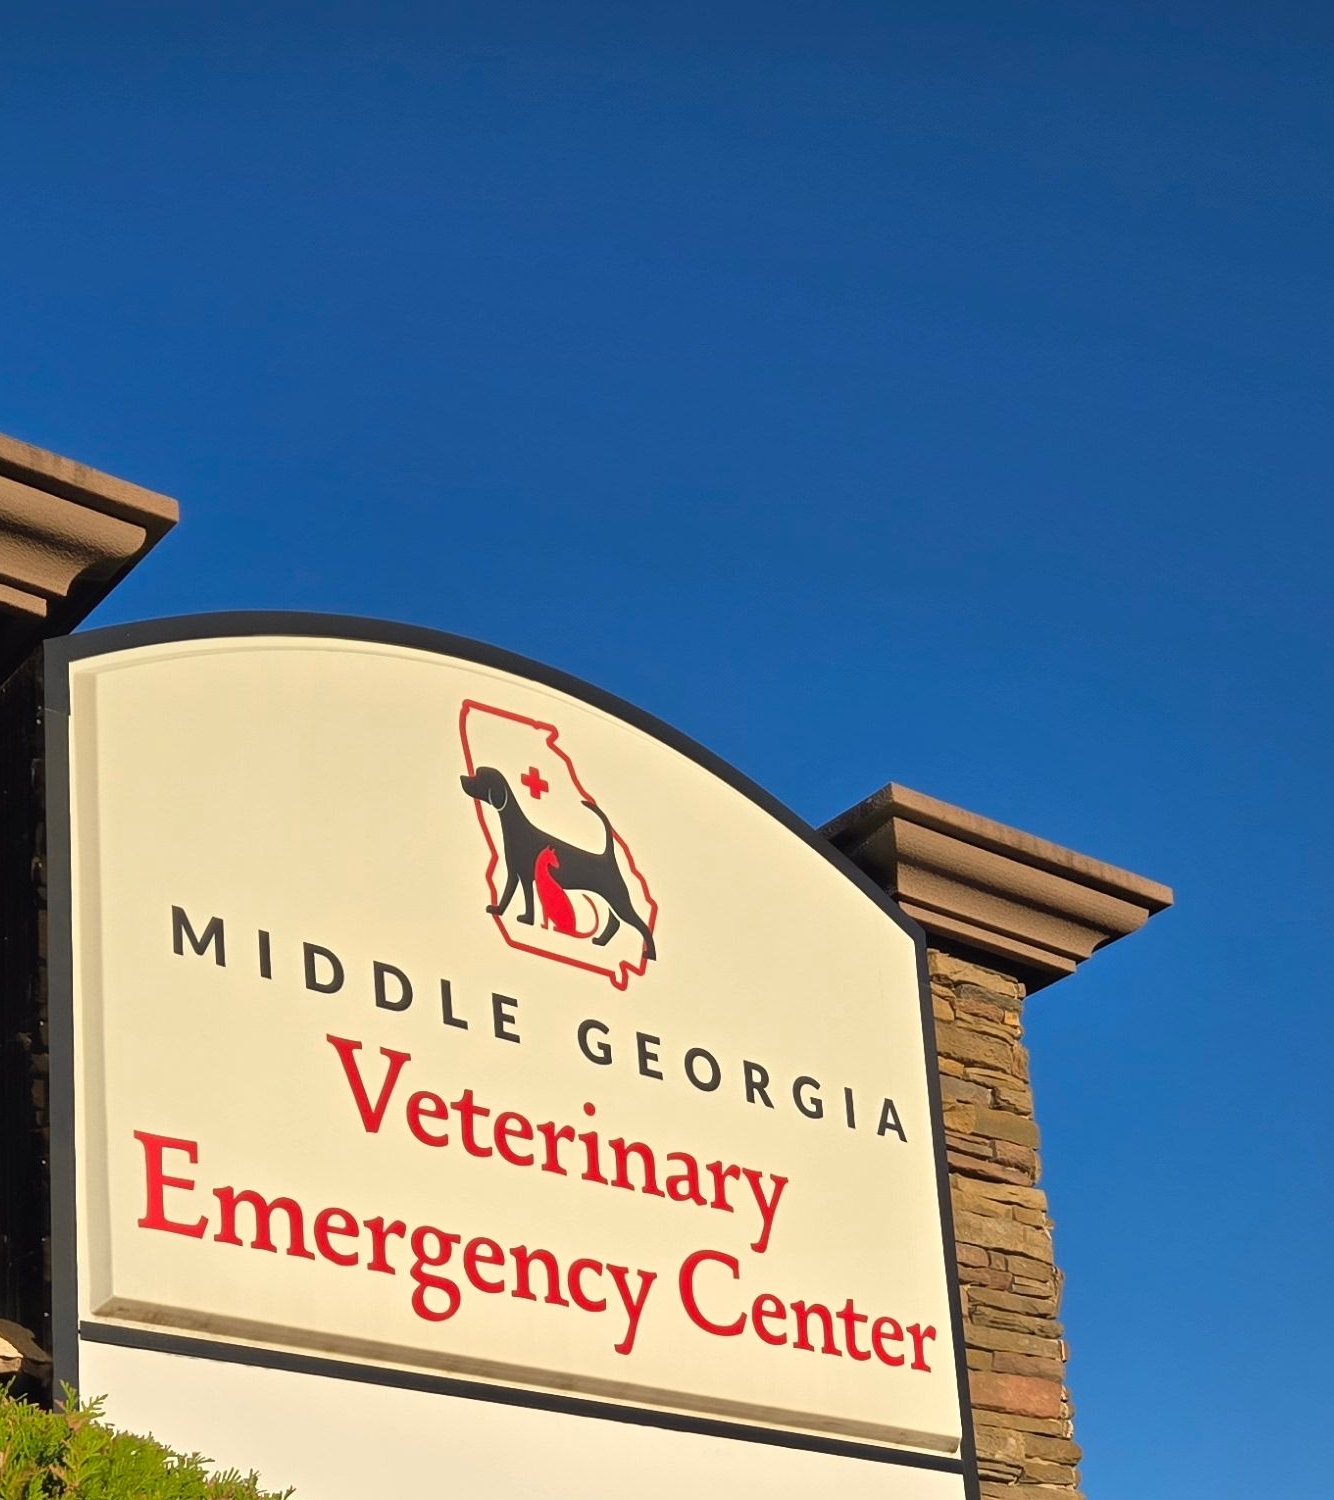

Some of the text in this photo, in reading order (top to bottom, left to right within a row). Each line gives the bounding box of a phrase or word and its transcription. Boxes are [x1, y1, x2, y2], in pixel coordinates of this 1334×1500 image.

[171, 905, 908, 1143] MIDDLE GEORGIA
[133, 1130, 937, 1373] Emergency Center
[327, 1034, 788, 1254] Veterinary
